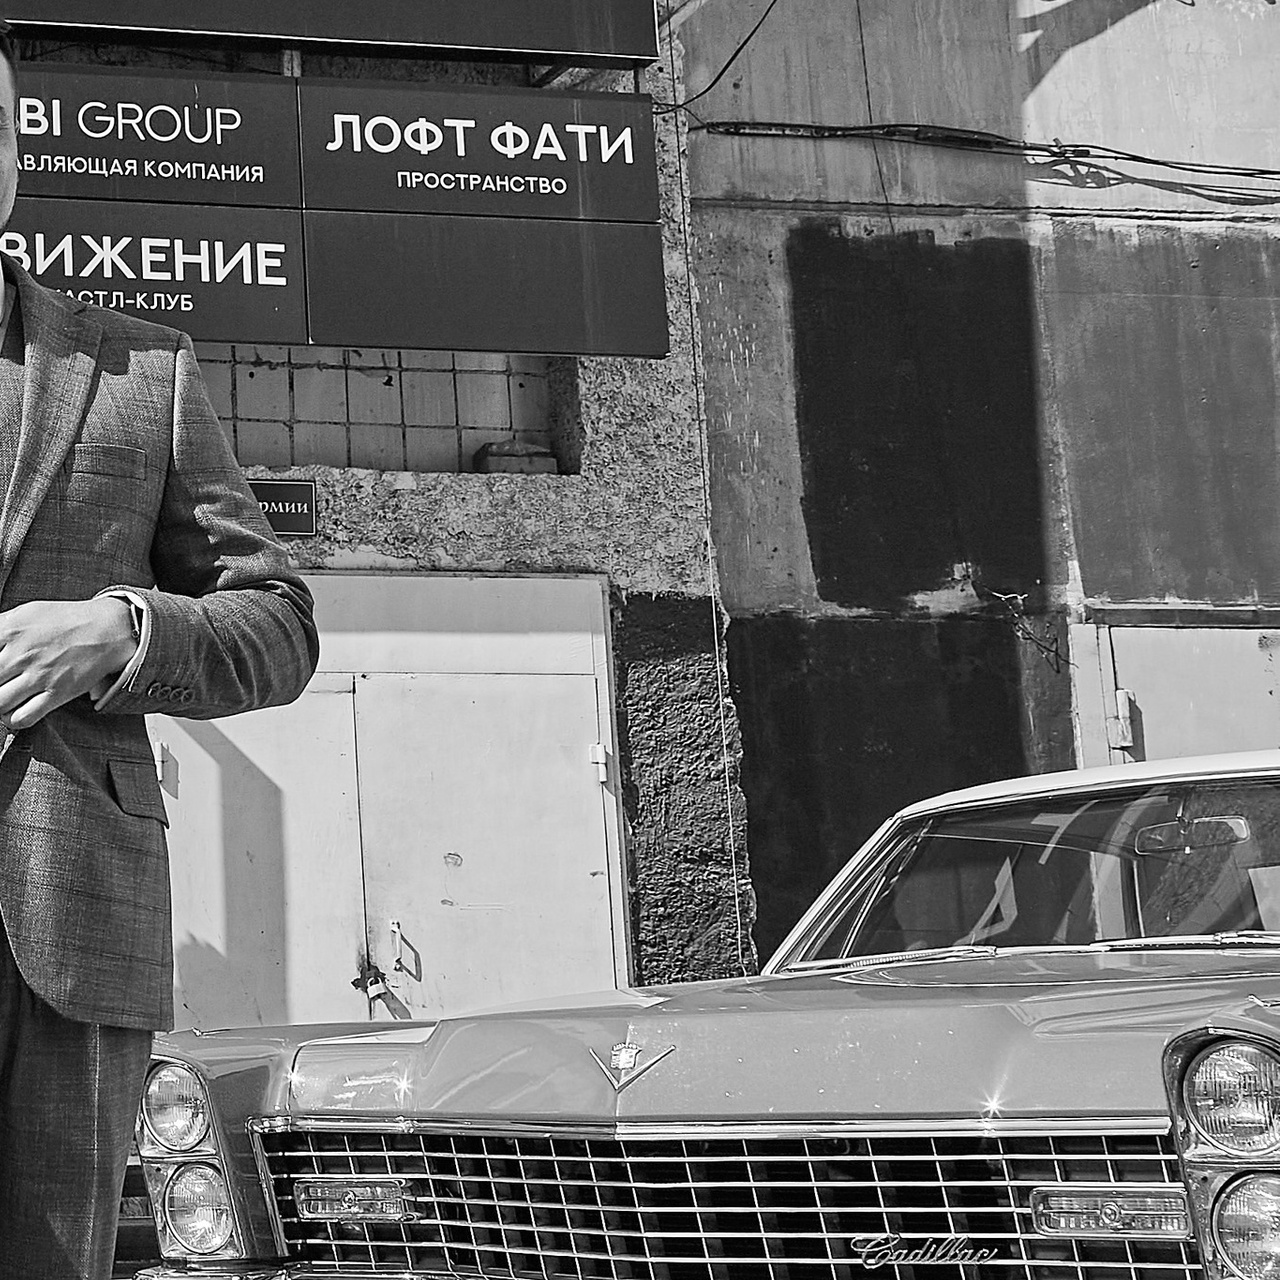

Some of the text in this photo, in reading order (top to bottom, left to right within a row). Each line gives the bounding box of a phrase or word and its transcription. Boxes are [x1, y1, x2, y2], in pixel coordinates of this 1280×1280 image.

[78, 102, 241, 144] GROUP
[326, 114, 633, 163] ЛОФТ ФАТИ
[145, 161, 263, 182] КОМПАНИЯ
[398, 172, 566, 193] ПРОСТРАНСТВО
[850, 1233, 999, 1269] Cadillac
